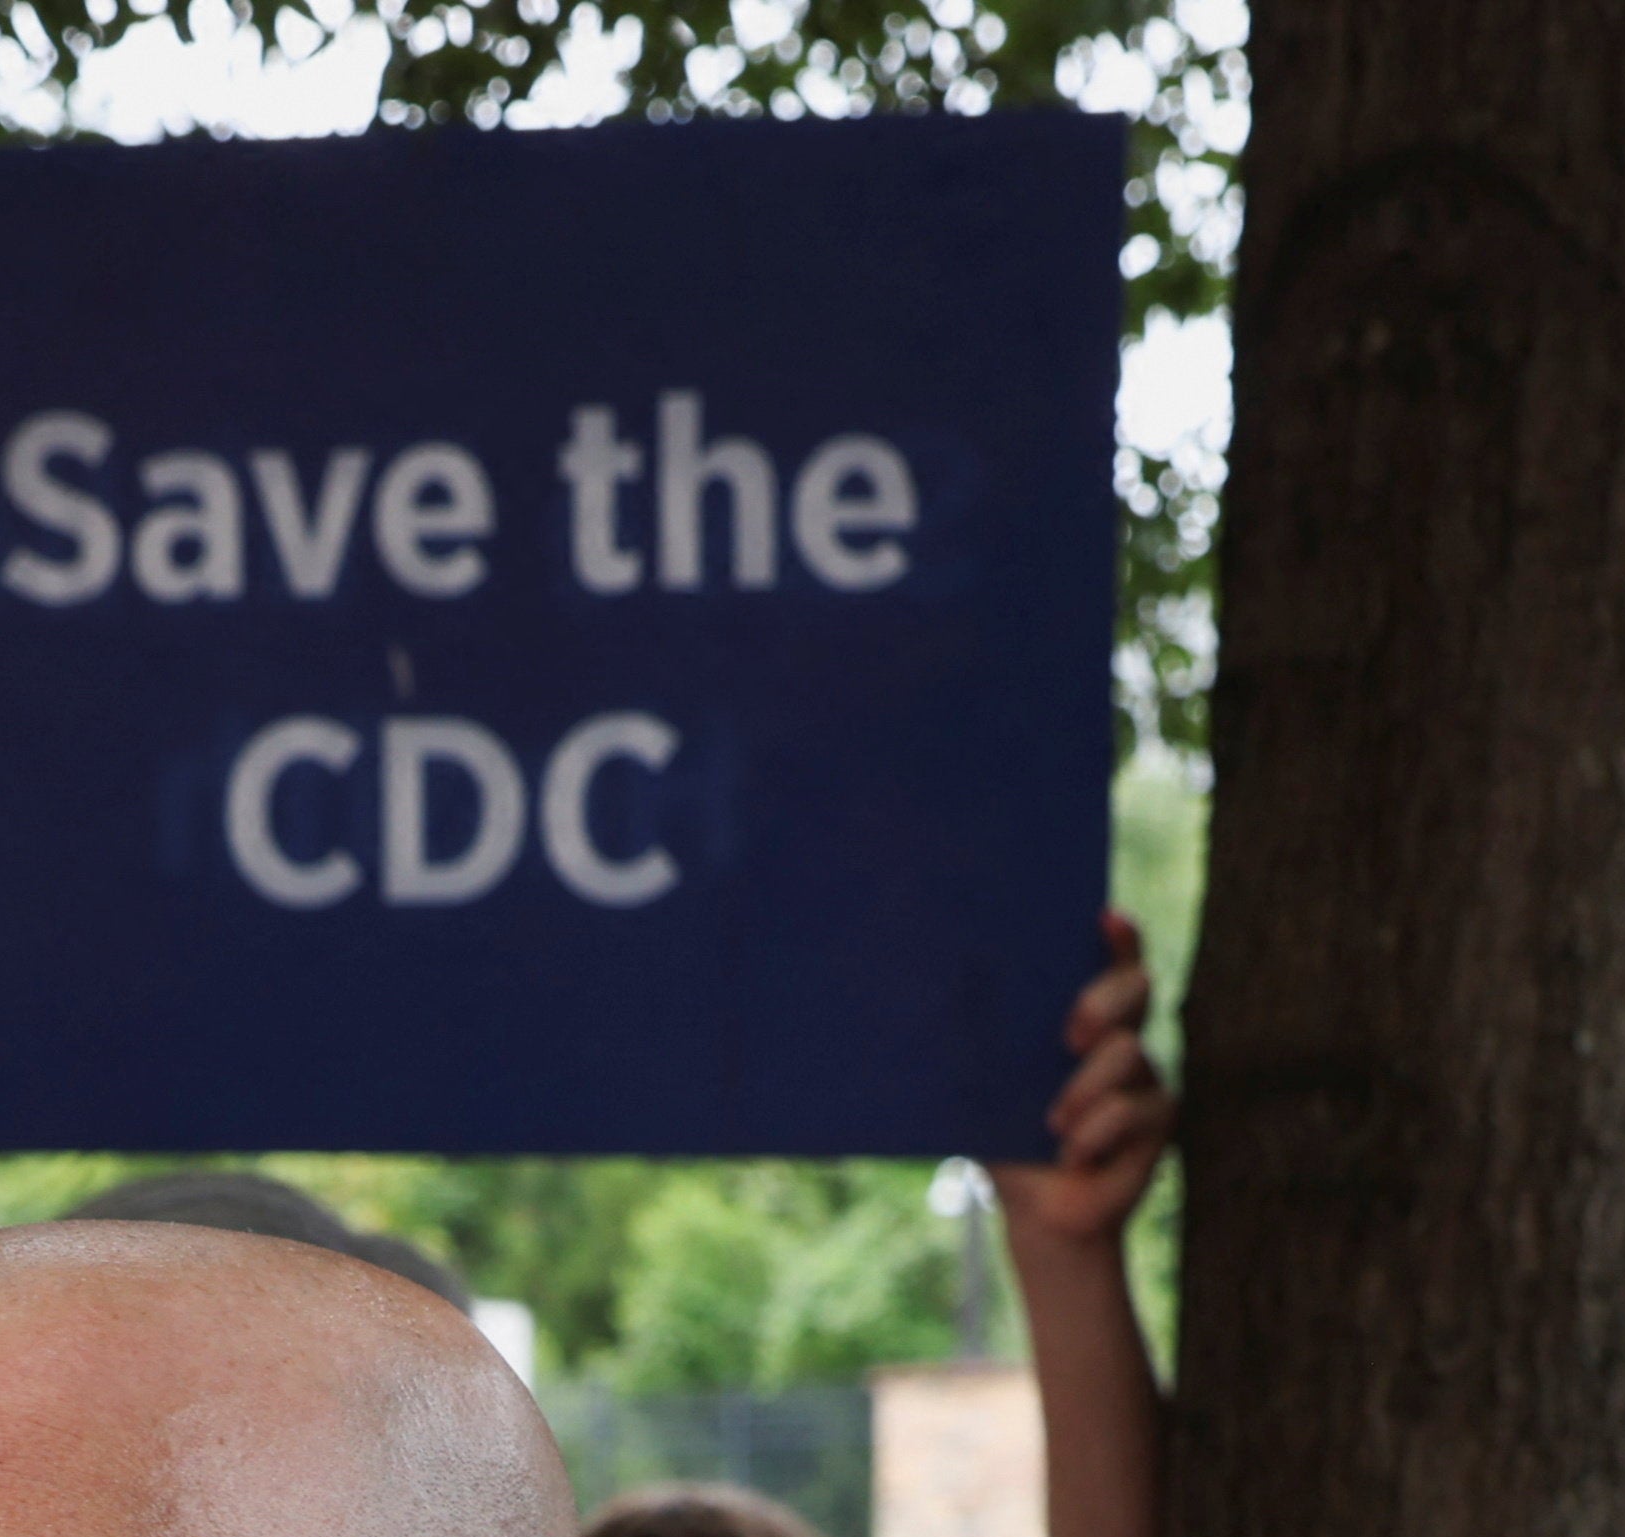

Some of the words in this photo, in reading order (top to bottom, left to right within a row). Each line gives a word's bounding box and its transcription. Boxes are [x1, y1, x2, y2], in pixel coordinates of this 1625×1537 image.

[0, 408, 498, 606] Save
[559, 390, 919, 594] the
[224, 713, 682, 910] CDC
